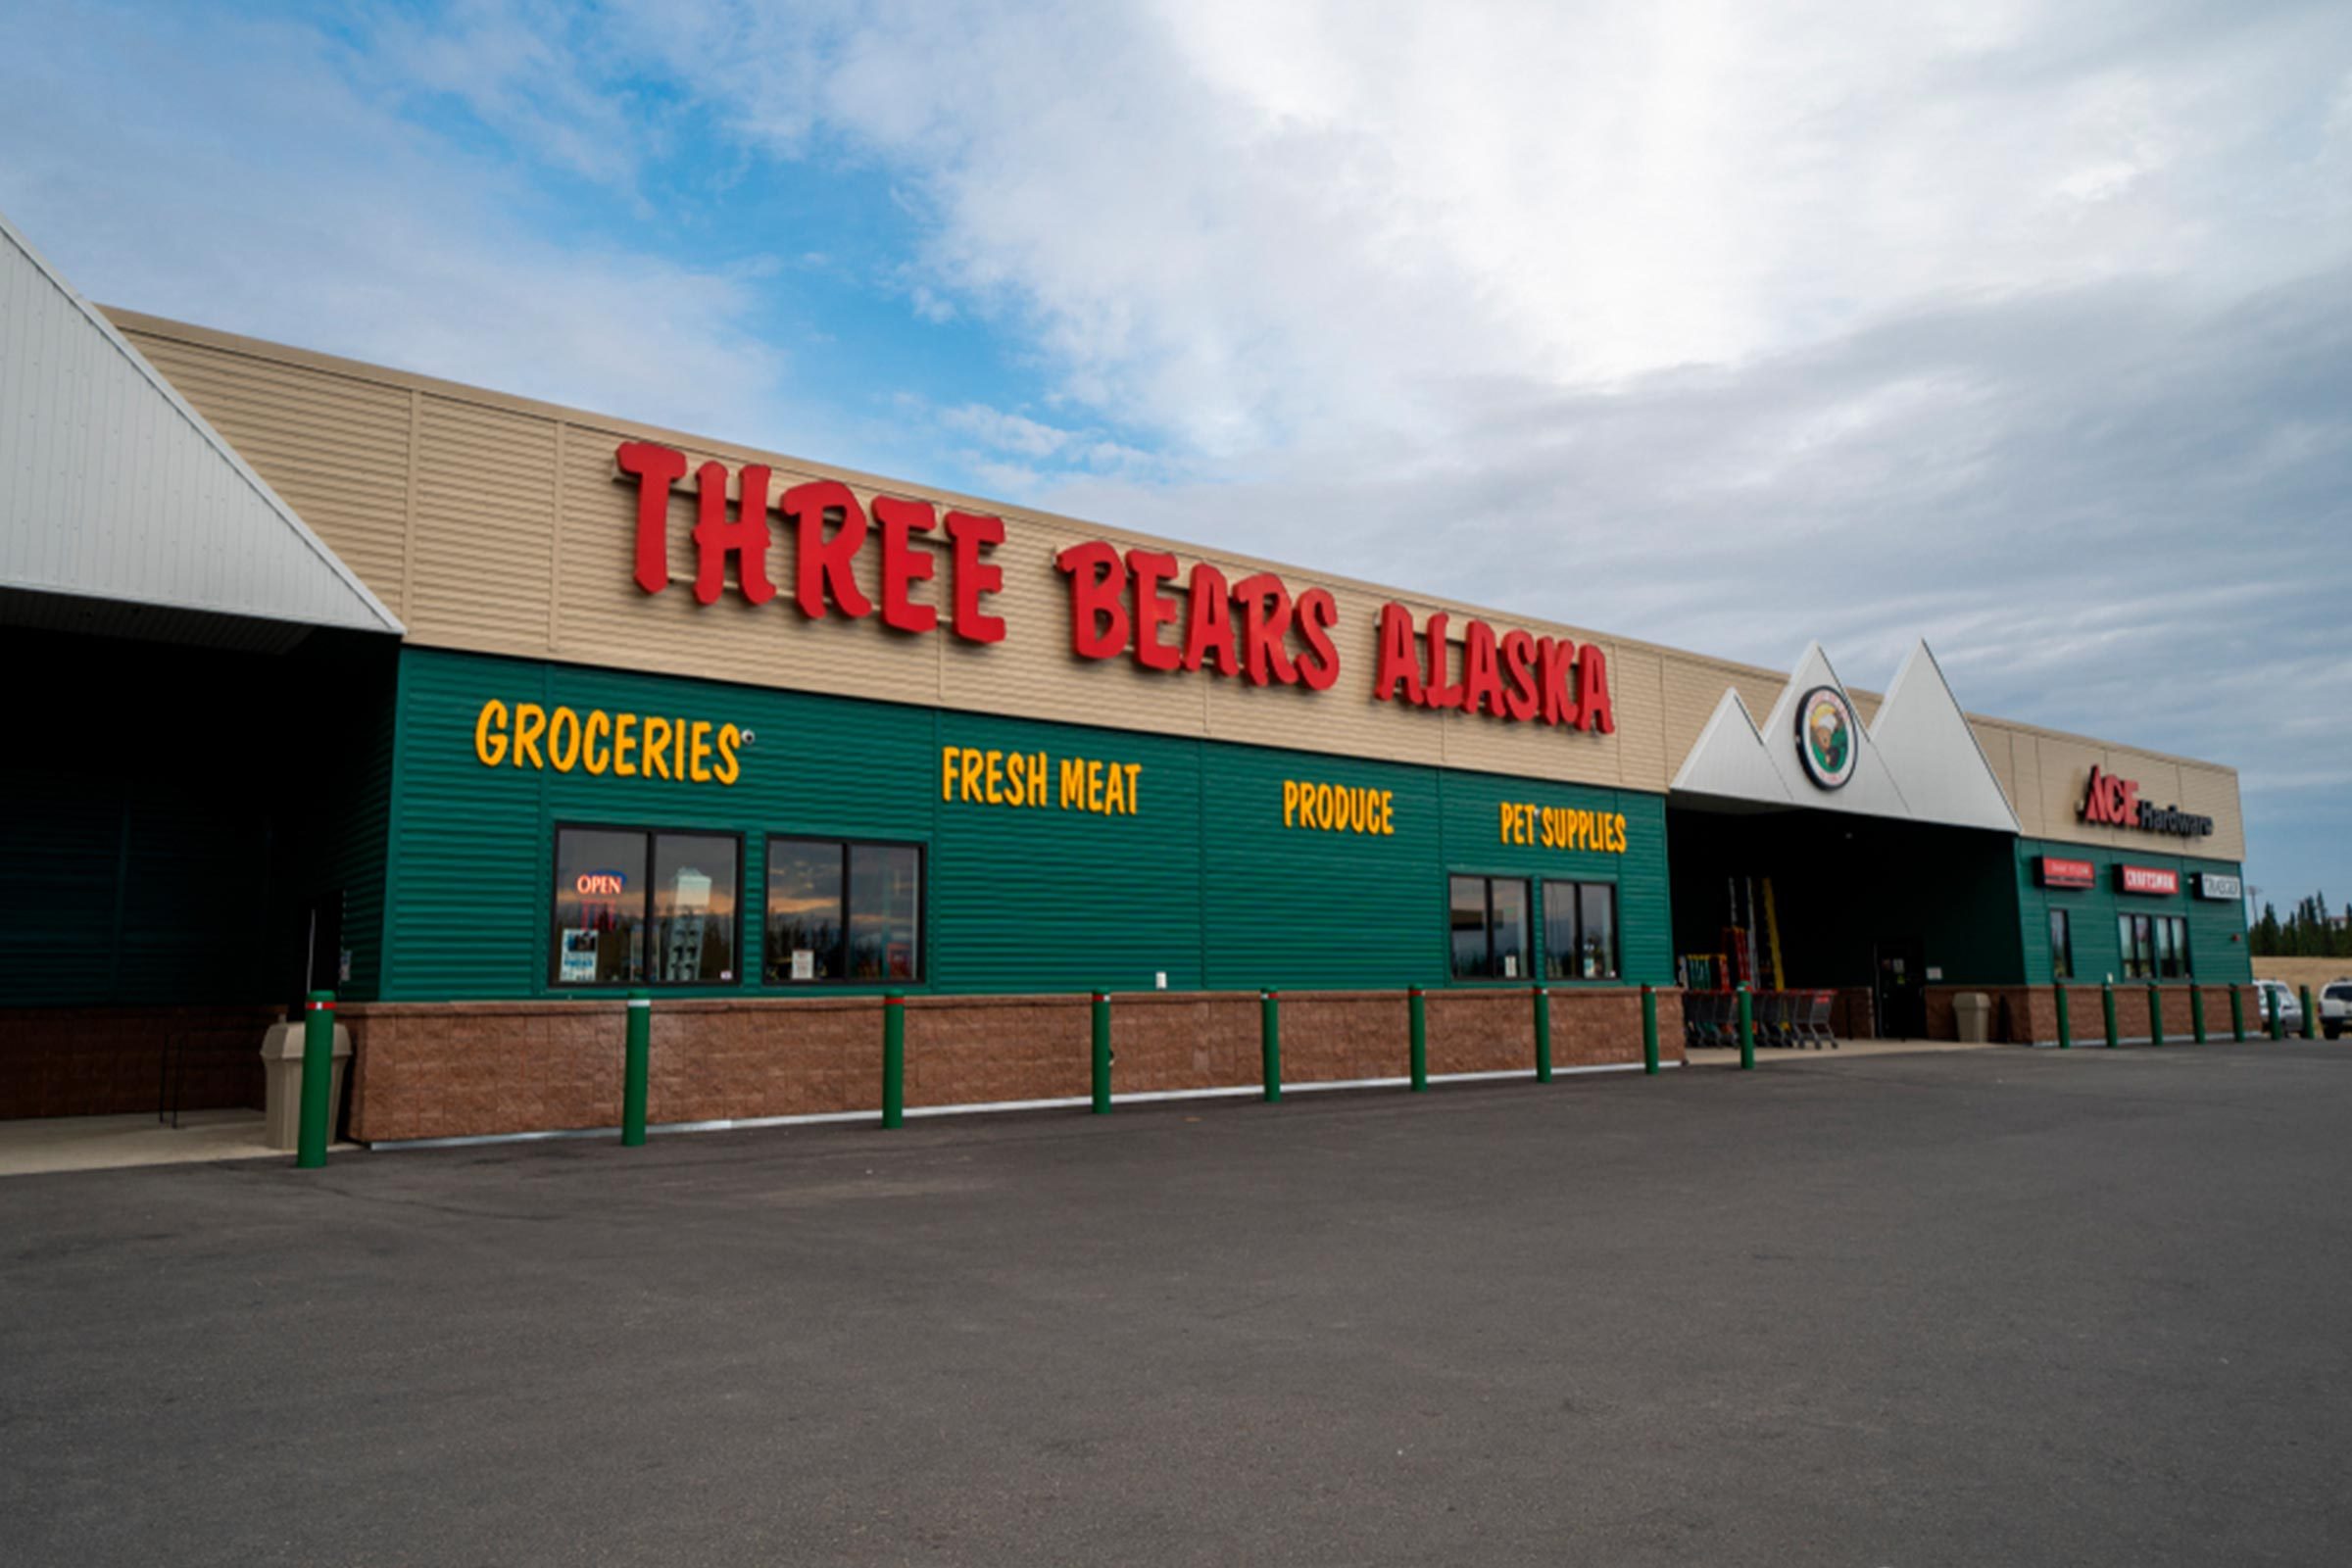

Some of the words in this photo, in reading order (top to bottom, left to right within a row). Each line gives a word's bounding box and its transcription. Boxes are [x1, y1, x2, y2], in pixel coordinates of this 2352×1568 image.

[615, 441, 1006, 645] THREE
[1054, 540, 1340, 692] BEARS
[1373, 601, 1616, 735] ALASKA
[474, 698, 742, 786] GROCERIES
[942, 746, 1048, 808] FRESH
[1059, 758, 1143, 816] MEAT
[1283, 779, 1395, 835] PRODUCE
[2084, 763, 2139, 827] ACE
[2139, 799, 2214, 837] Hardware
[1499, 801, 1537, 846] PET
[1540, 806, 1627, 854] SUPPLIES
[576, 874, 622, 895] OPEN
